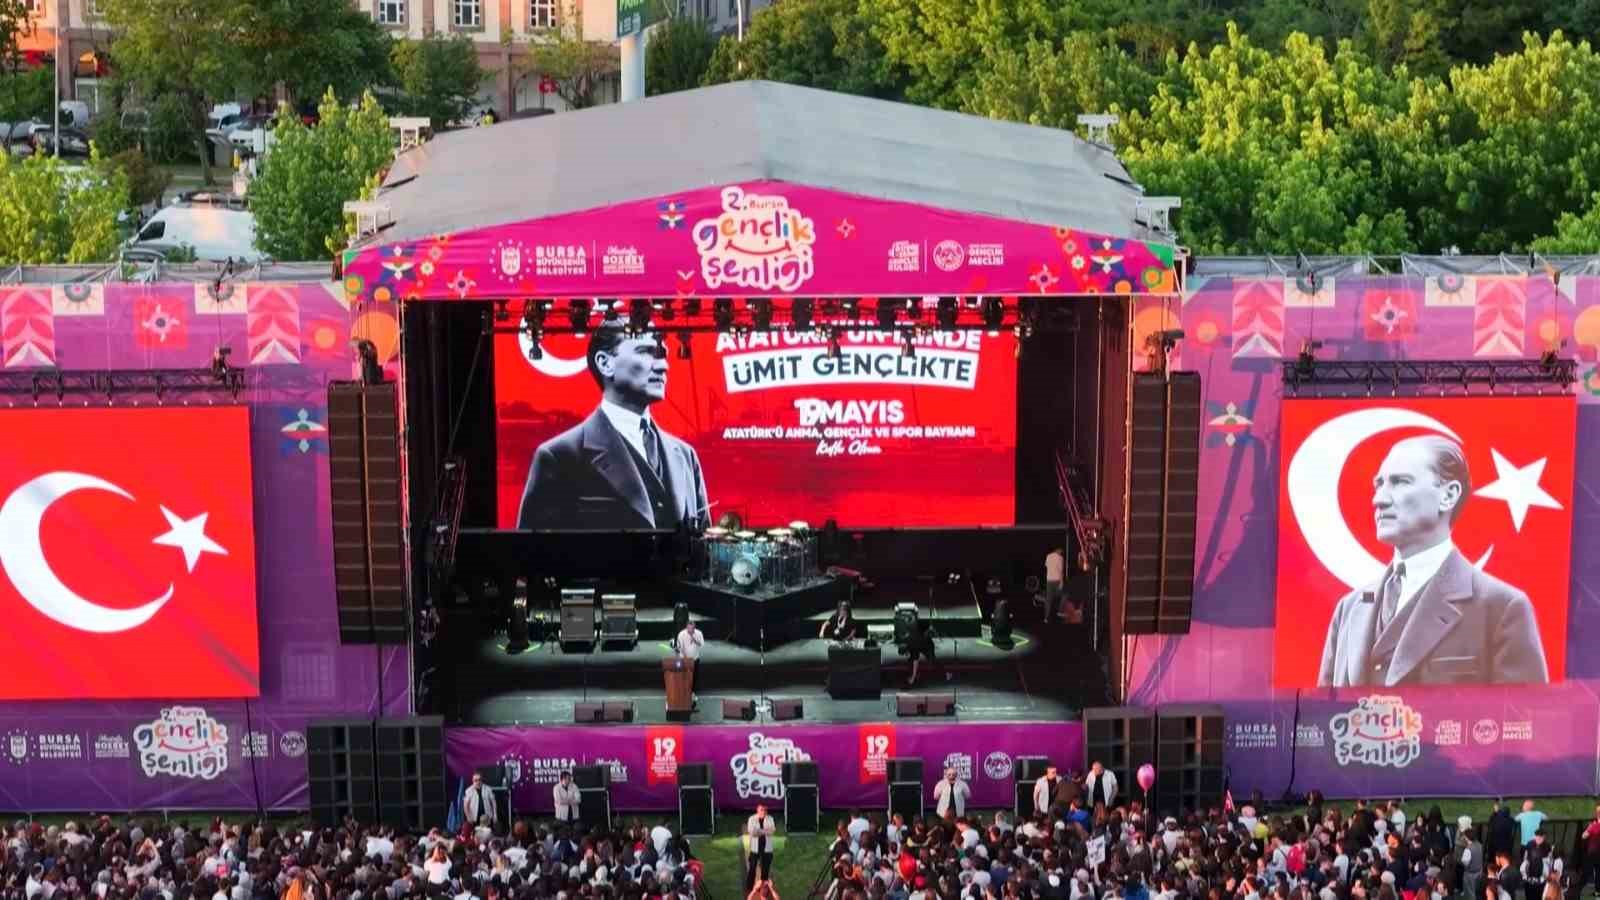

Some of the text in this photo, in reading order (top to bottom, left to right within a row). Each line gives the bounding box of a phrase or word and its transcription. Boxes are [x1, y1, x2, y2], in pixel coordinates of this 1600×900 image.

[727, 192, 748, 211] 2.
[699, 211, 811, 251] gençlik
[536, 246, 586, 257] BURSA
[707, 250, 809, 287] şenliği
[733, 353, 973, 386] ÜMİT GENÇLİKTE
[794, 398, 904, 426] 19 MAYIS
[723, 425, 976, 440] ATATÜRK'Ü ANMA, GENÇLİK VE SPOR BAYRAMI
[1235, 724, 1277, 734] BURSA
[1334, 705, 1421, 737] gençlik
[39, 734, 80, 744] BURSA
[138, 719, 225, 748] gençlik
[653, 737, 677, 757] 19
[866, 735, 889, 754] 19
[1340, 737, 1419, 765] şenliği
[145, 748, 224, 776] şenliği
[533, 758, 577, 768] BURSA
[740, 777, 782, 796] şenl
